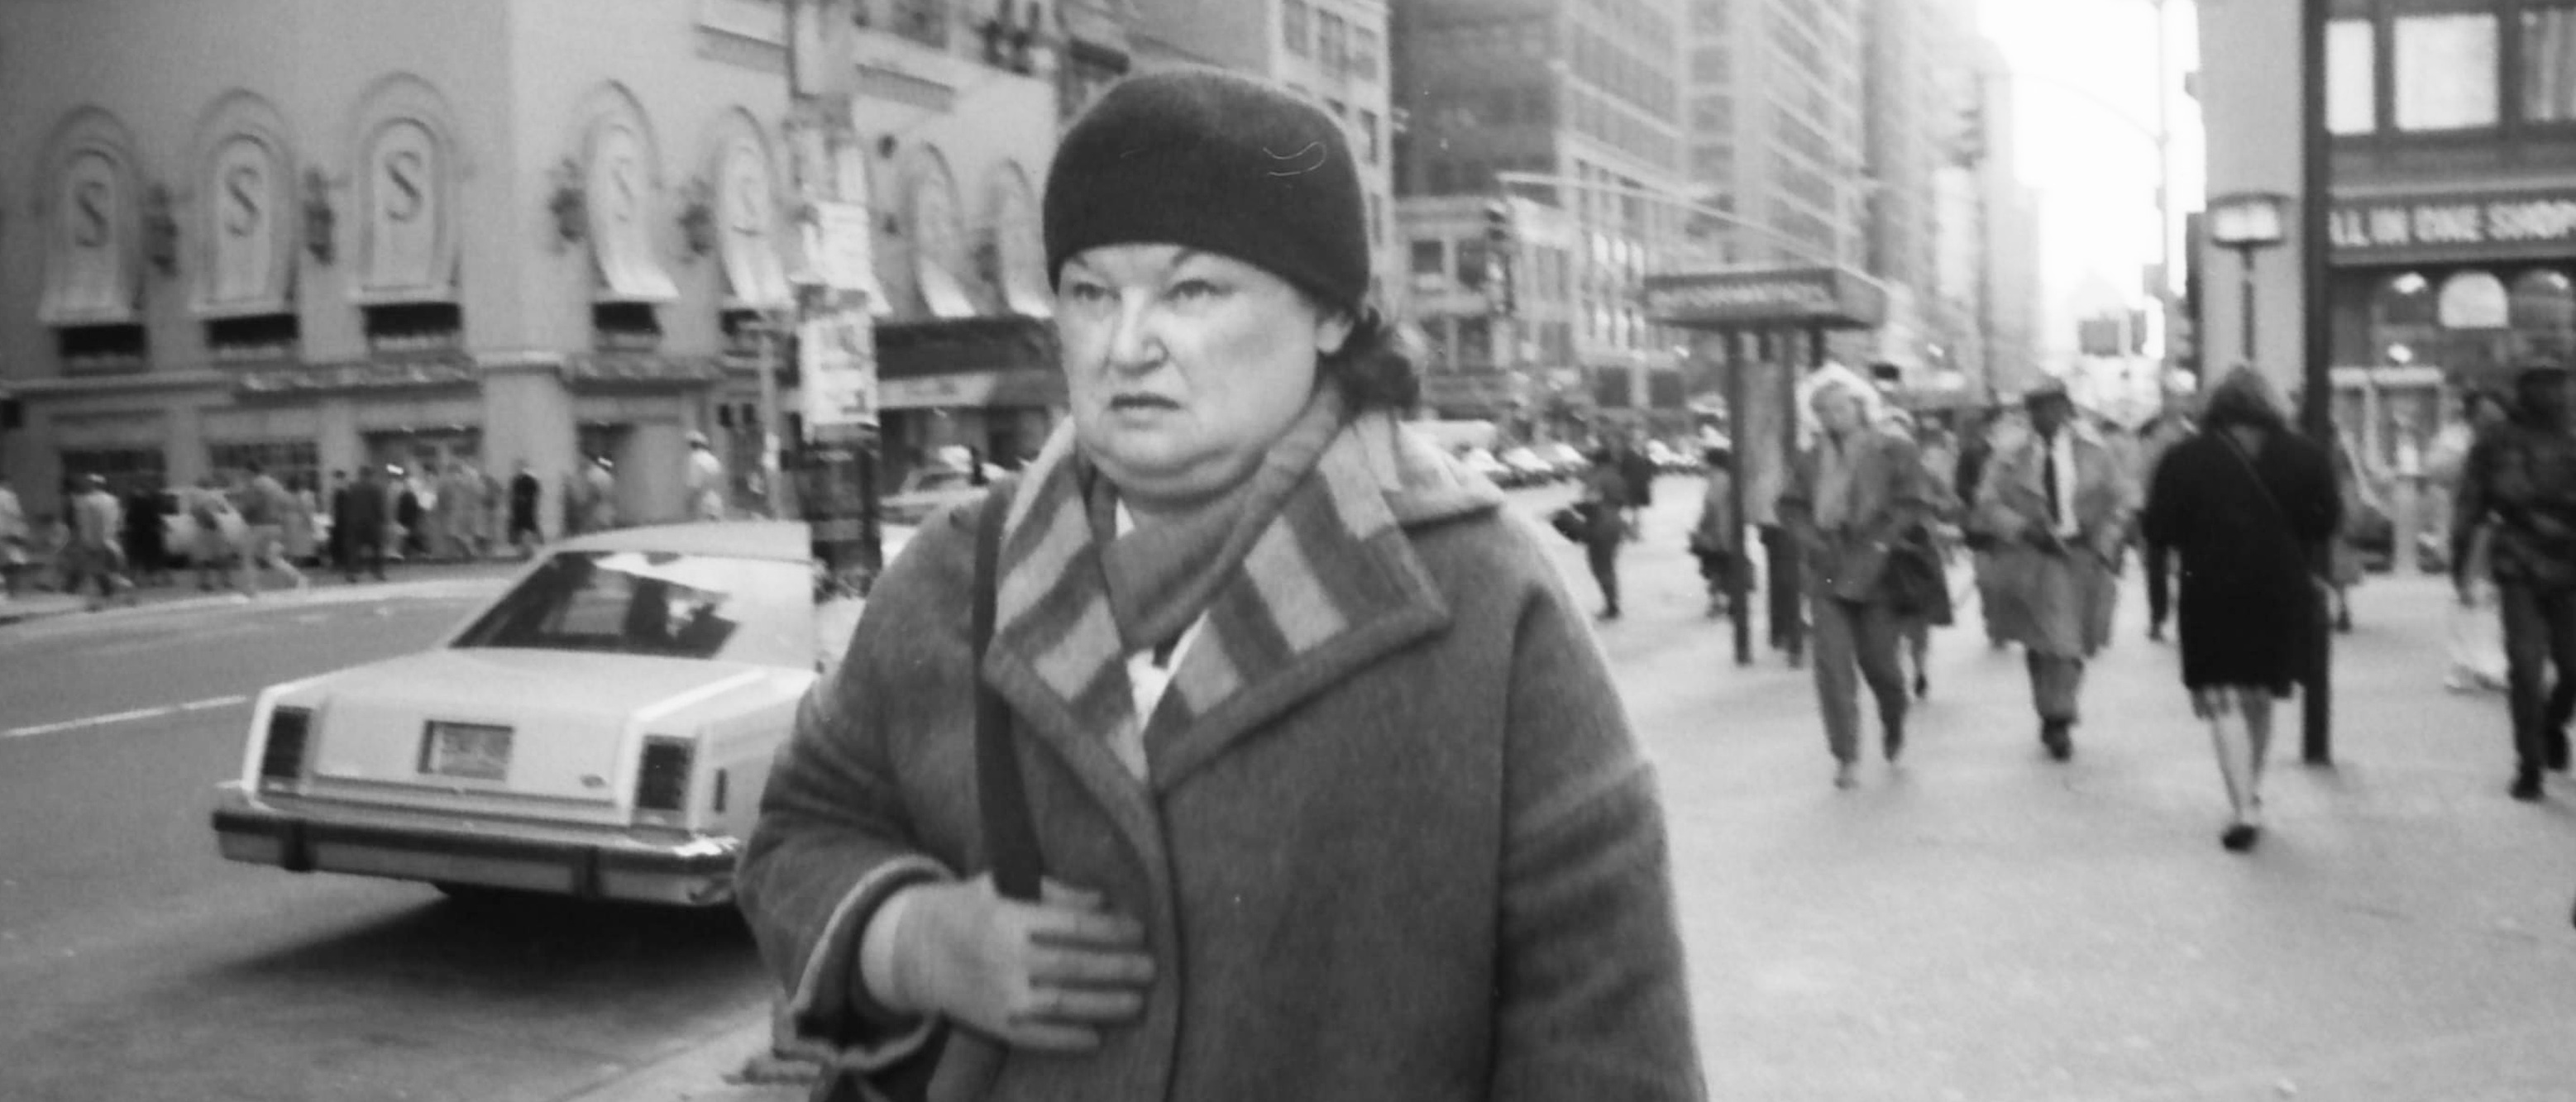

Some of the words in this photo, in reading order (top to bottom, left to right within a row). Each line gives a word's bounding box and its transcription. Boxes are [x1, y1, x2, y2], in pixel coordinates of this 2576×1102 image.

[76, 179, 110, 248] S
[225, 166, 260, 237] S
[385, 150, 423, 223] S
[2328, 210, 2370, 247] LL
[2370, 207, 2408, 245] IN
[2413, 205, 2483, 242] ONE
